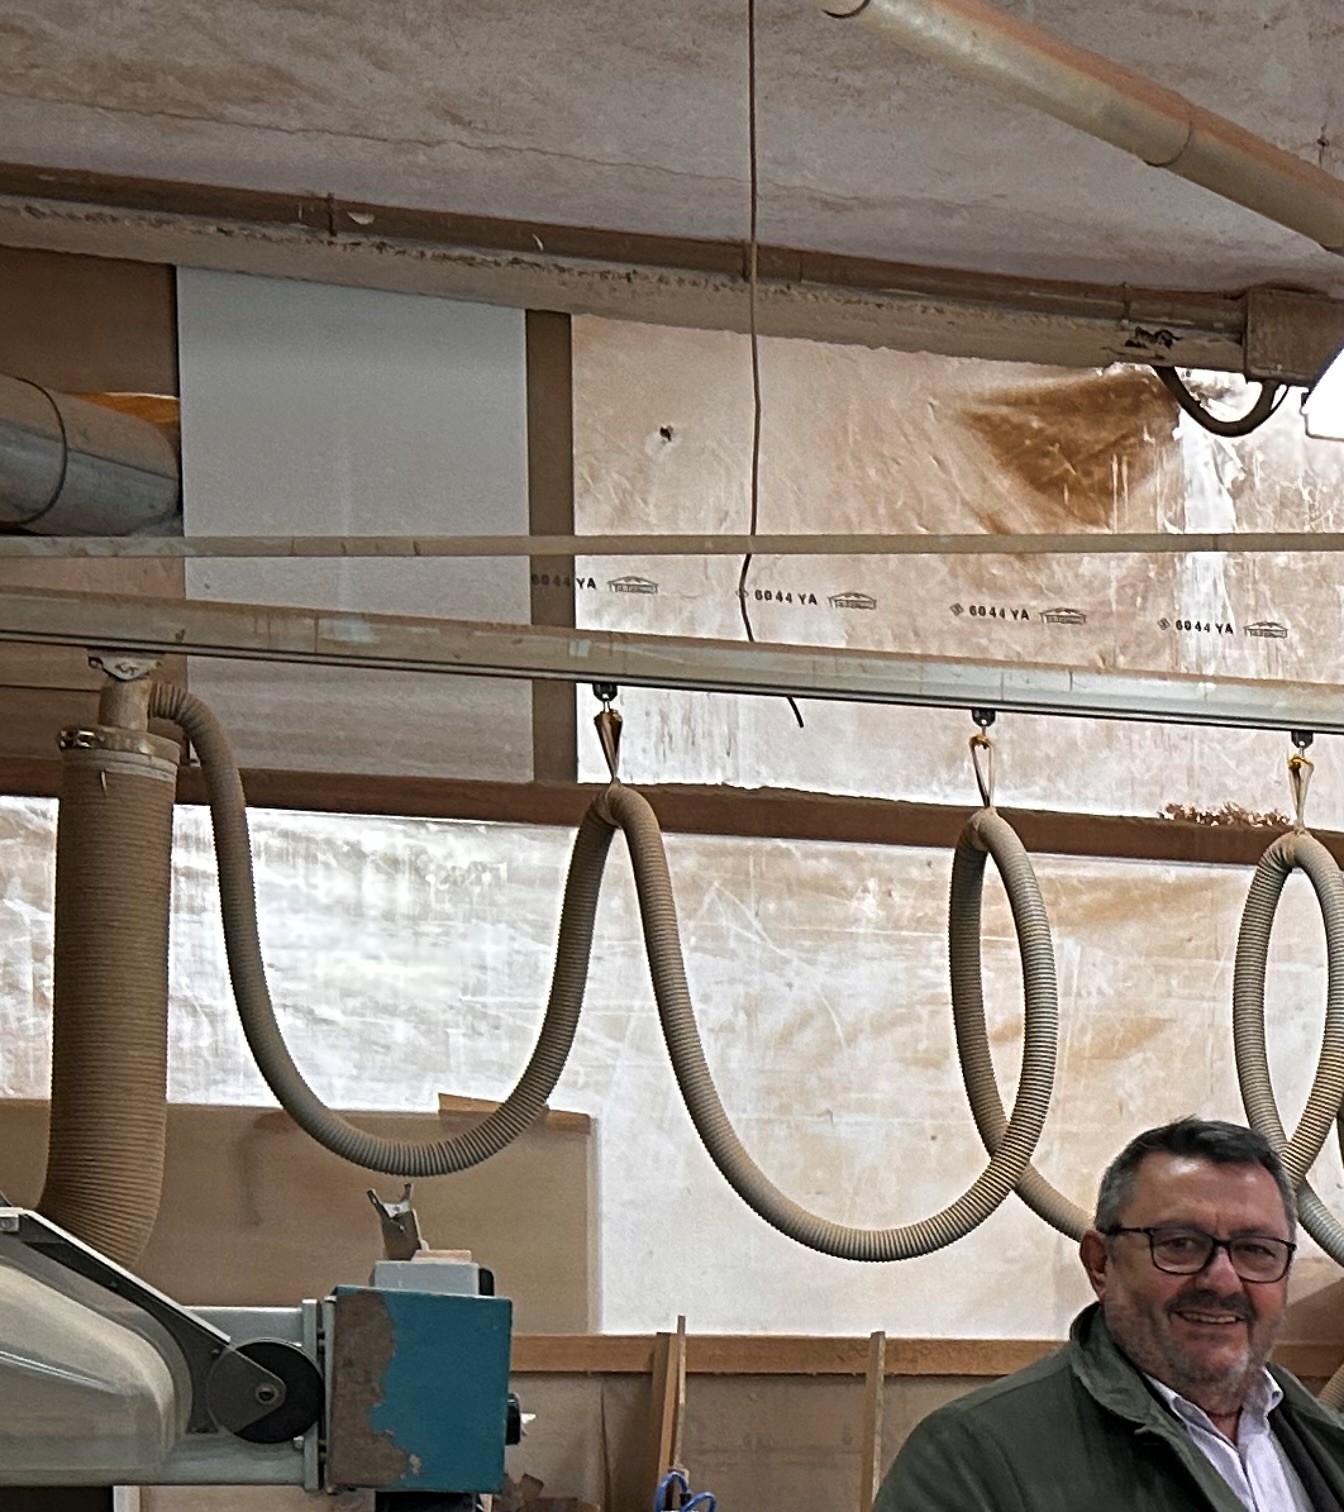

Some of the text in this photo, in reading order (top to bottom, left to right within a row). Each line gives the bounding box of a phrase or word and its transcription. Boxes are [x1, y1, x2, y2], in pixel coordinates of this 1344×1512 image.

[798, 592, 819, 606] YA
[1011, 608, 1030, 621] YA
[1215, 623, 1234, 635] YA
